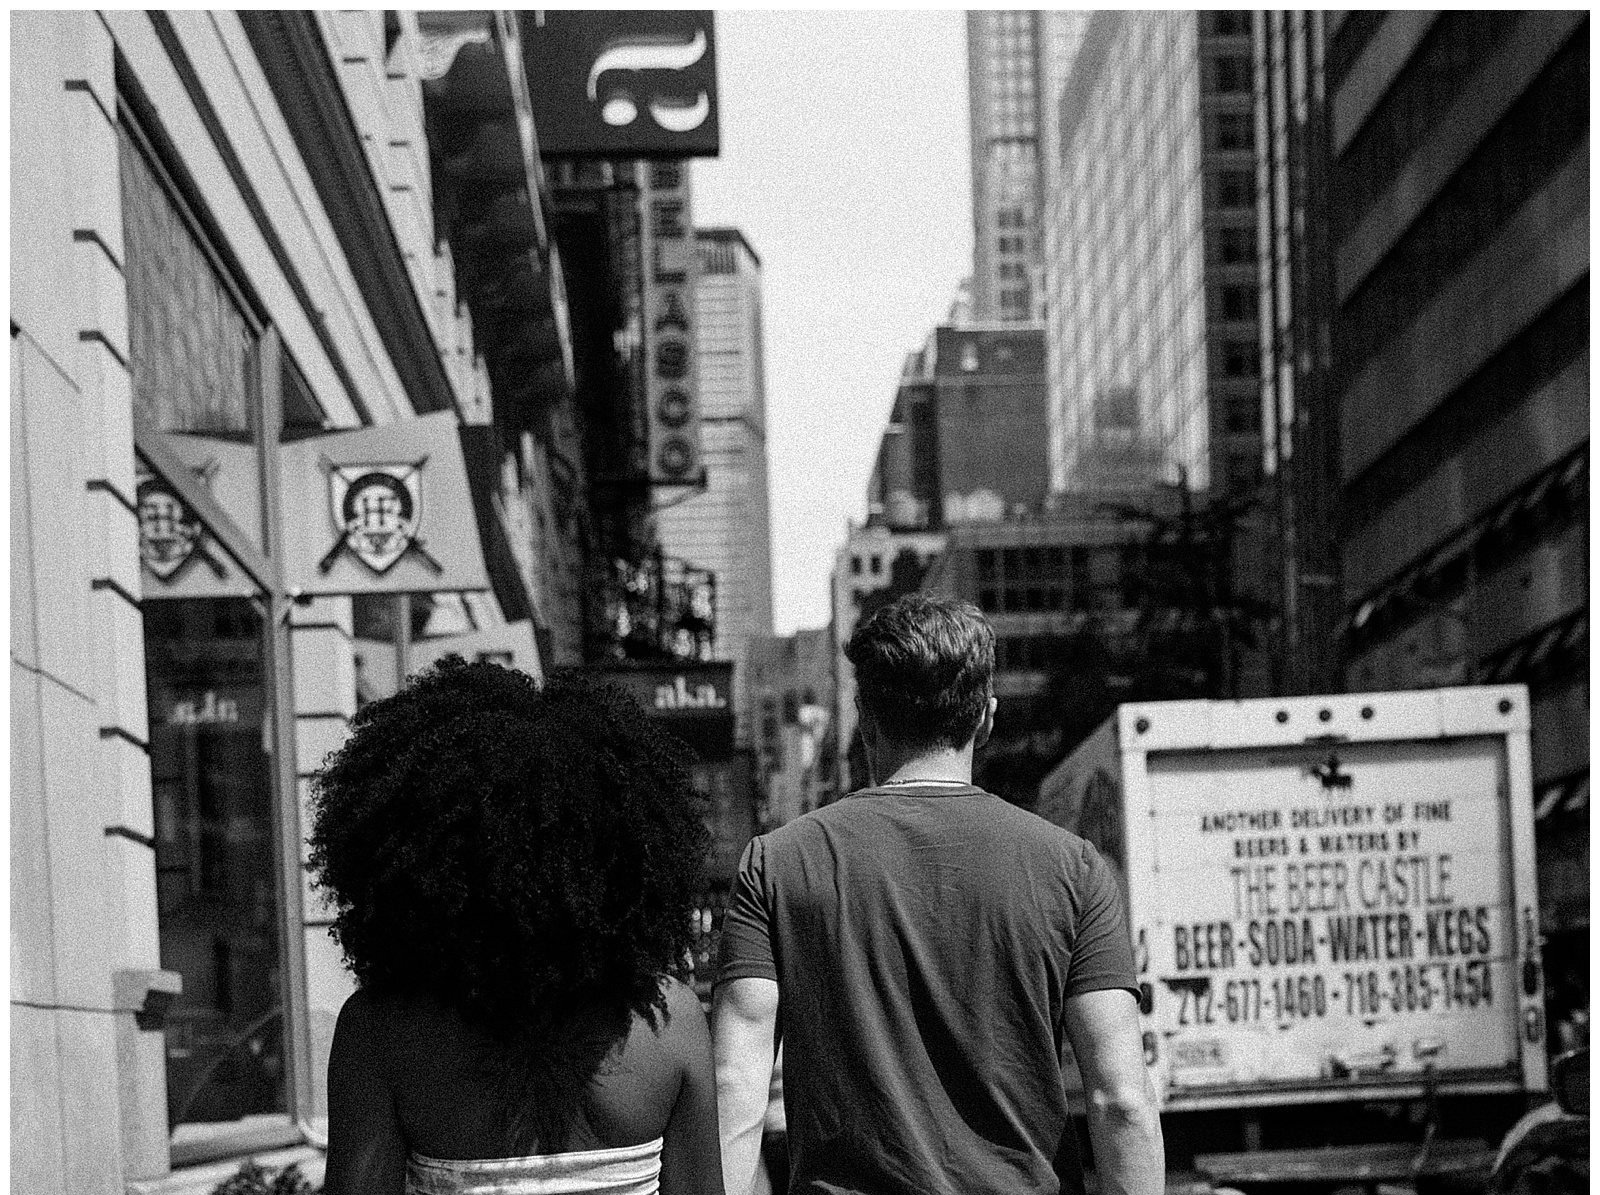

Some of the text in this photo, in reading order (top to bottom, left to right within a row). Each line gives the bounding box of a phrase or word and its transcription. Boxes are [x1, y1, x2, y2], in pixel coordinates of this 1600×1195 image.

[586, 28, 710, 132] a
[1201, 801, 1451, 833] ANOTHER DELIVERY OF FINE
[1234, 831, 1420, 858] BEERS & WATERS BY
[1231, 853, 1453, 917] THE BEER CASTLE
